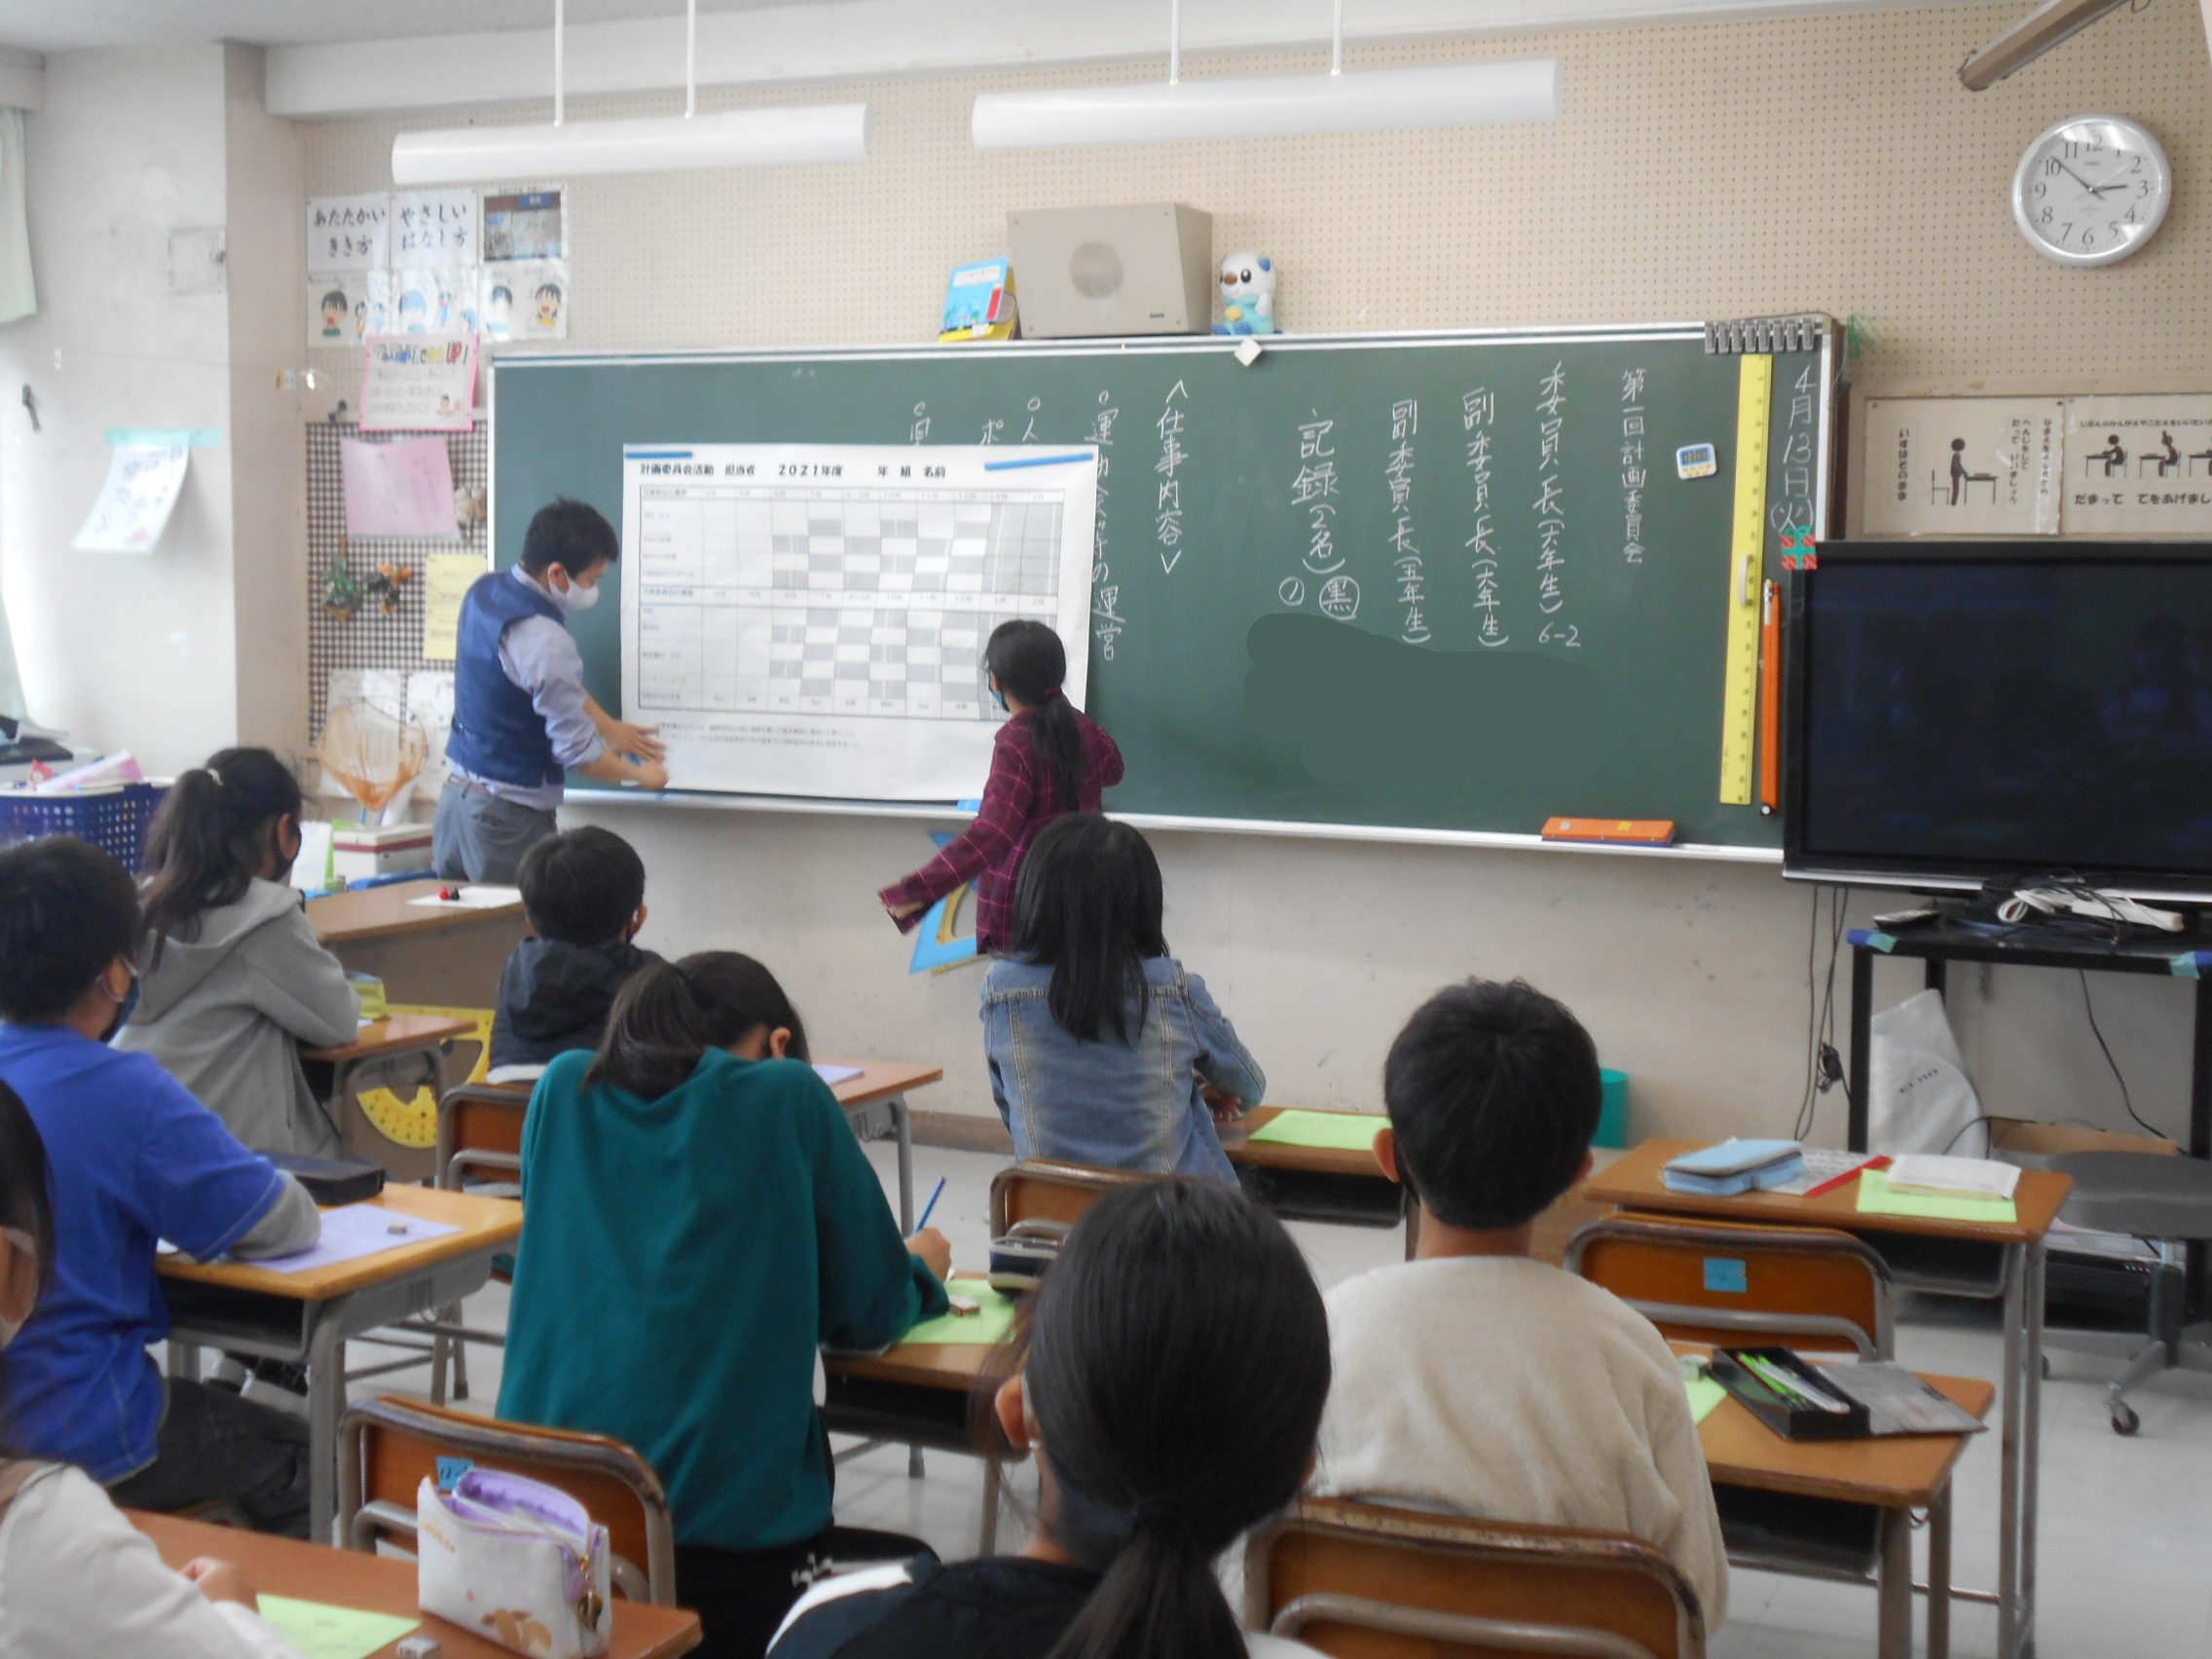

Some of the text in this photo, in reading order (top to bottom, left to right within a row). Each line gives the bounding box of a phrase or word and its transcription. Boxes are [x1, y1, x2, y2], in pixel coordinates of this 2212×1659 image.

[2064, 140, 2079, 159] 11
[2084, 134, 2103, 152] 12
[2045, 159, 2062, 176] 10
[2130, 156, 2141, 173] 2
[2035, 182, 2046, 201] 9
[2137, 180, 2149, 199] 3
[313, 207, 386, 227] あたたかい
[399, 203, 467, 227] やさしい
[2041, 205, 2053, 224] 8
[2124, 204, 2135, 223] 4
[402, 228, 468, 249] はなし方
[2061, 222, 2073, 240] 7
[2082, 227, 2094, 245] 6
[2108, 221, 2119, 239] 5
[328, 235, 373, 257] きき方
[1619, 367, 1646, 564] 第一回計画委員会
[1538, 622, 1581, 647] 6-2
